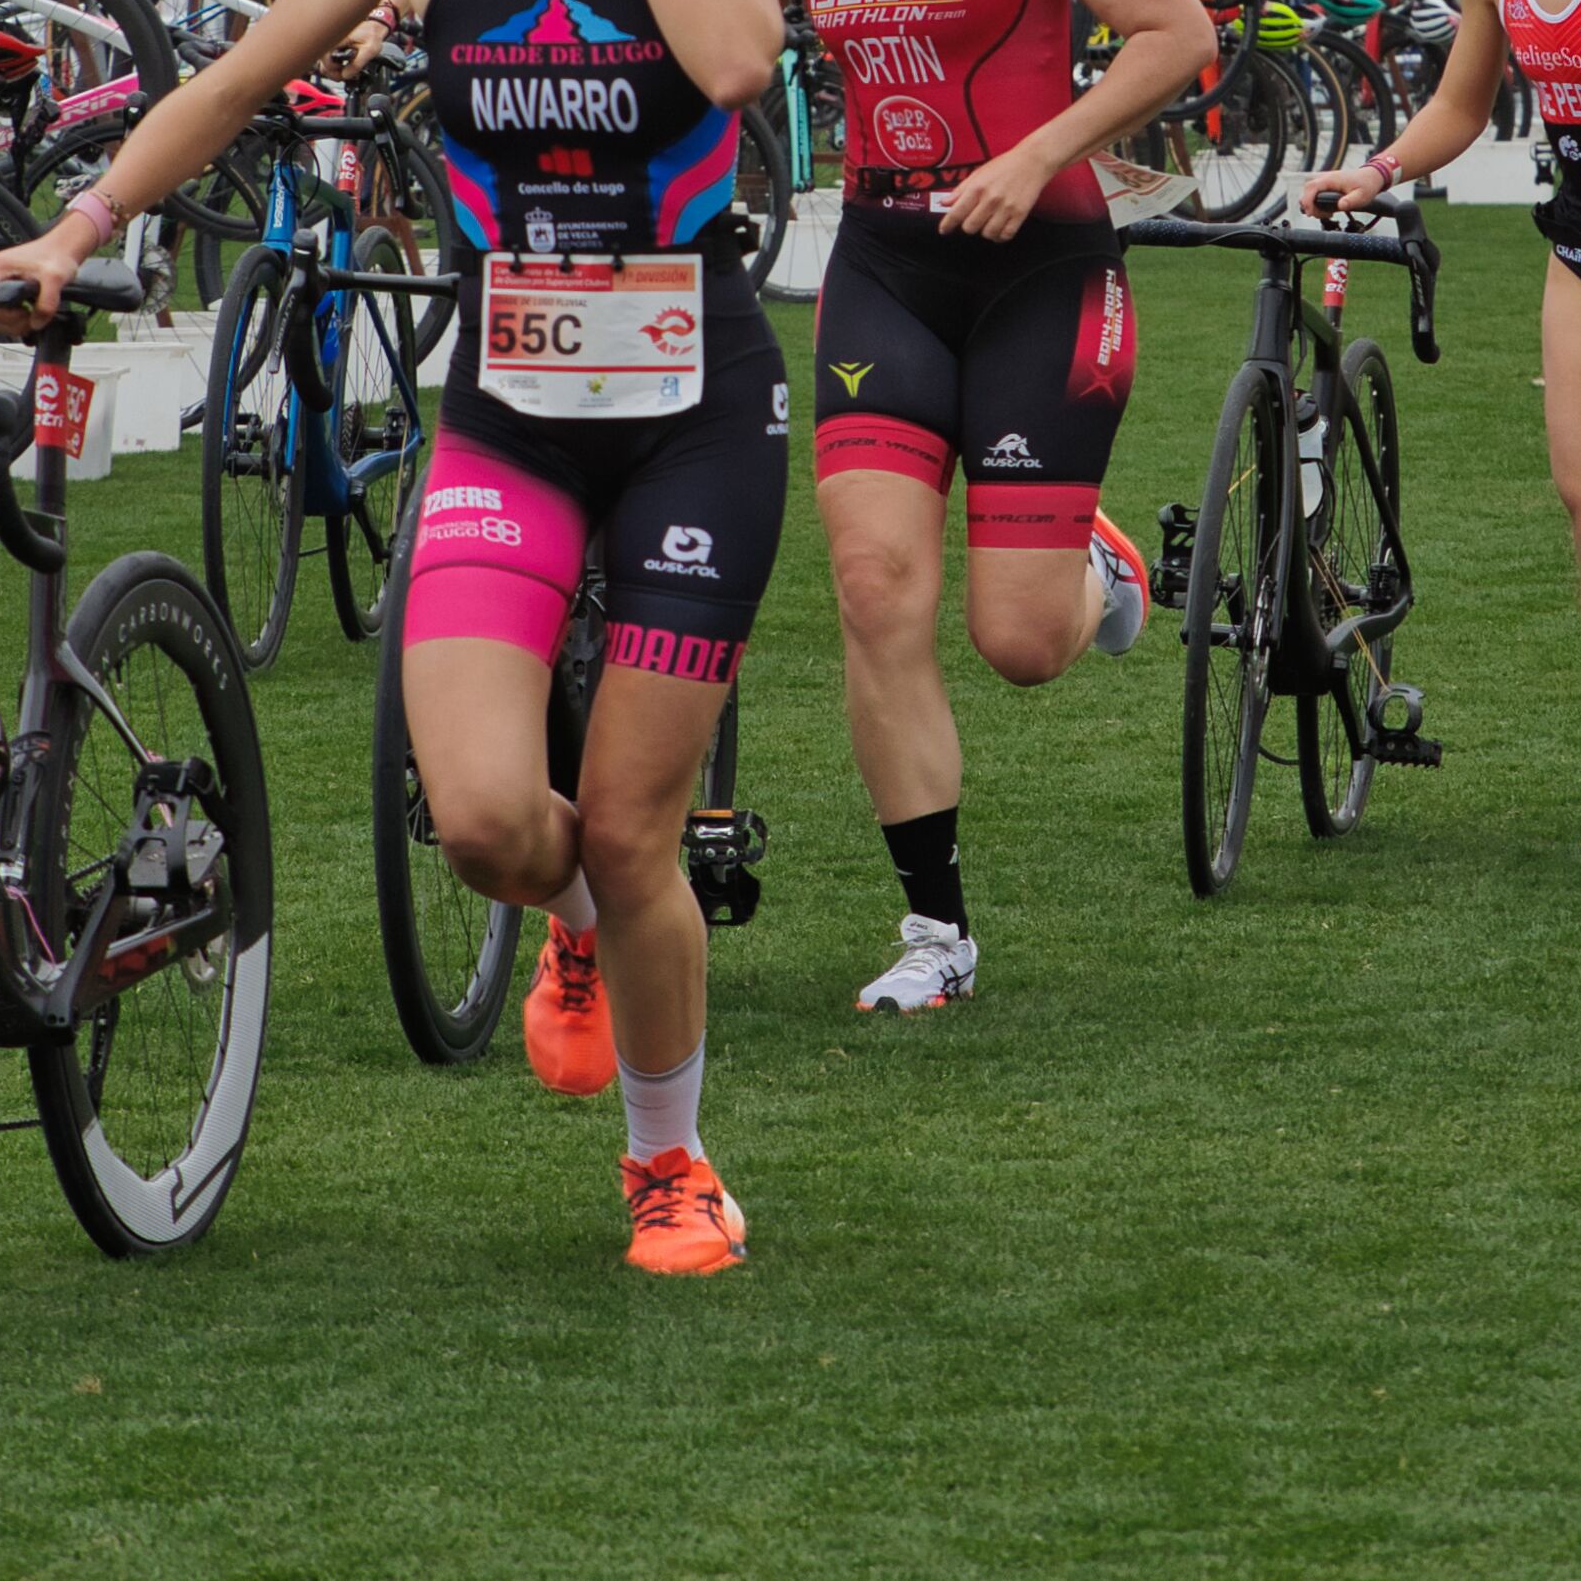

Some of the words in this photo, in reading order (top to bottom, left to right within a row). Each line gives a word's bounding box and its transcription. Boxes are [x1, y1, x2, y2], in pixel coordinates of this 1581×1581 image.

[928, 10, 966, 22] TEAM
[451, 42, 541, 66] CIDADE
[549, 43, 585, 67] DE
[591, 41, 664, 65] LUGO
[843, 23, 946, 84] ORTÍN
[470, 76, 639, 134] NAVARRO
[518, 182, 567, 196] Concello
[572, 182, 589, 195] de
[591, 182, 626, 197] Lugo
[488, 313, 583, 357] 55C
[981, 457, 1044, 470] austral
[644, 559, 721, 579] austral
[118, 601, 230, 691] CARBONWORKS
